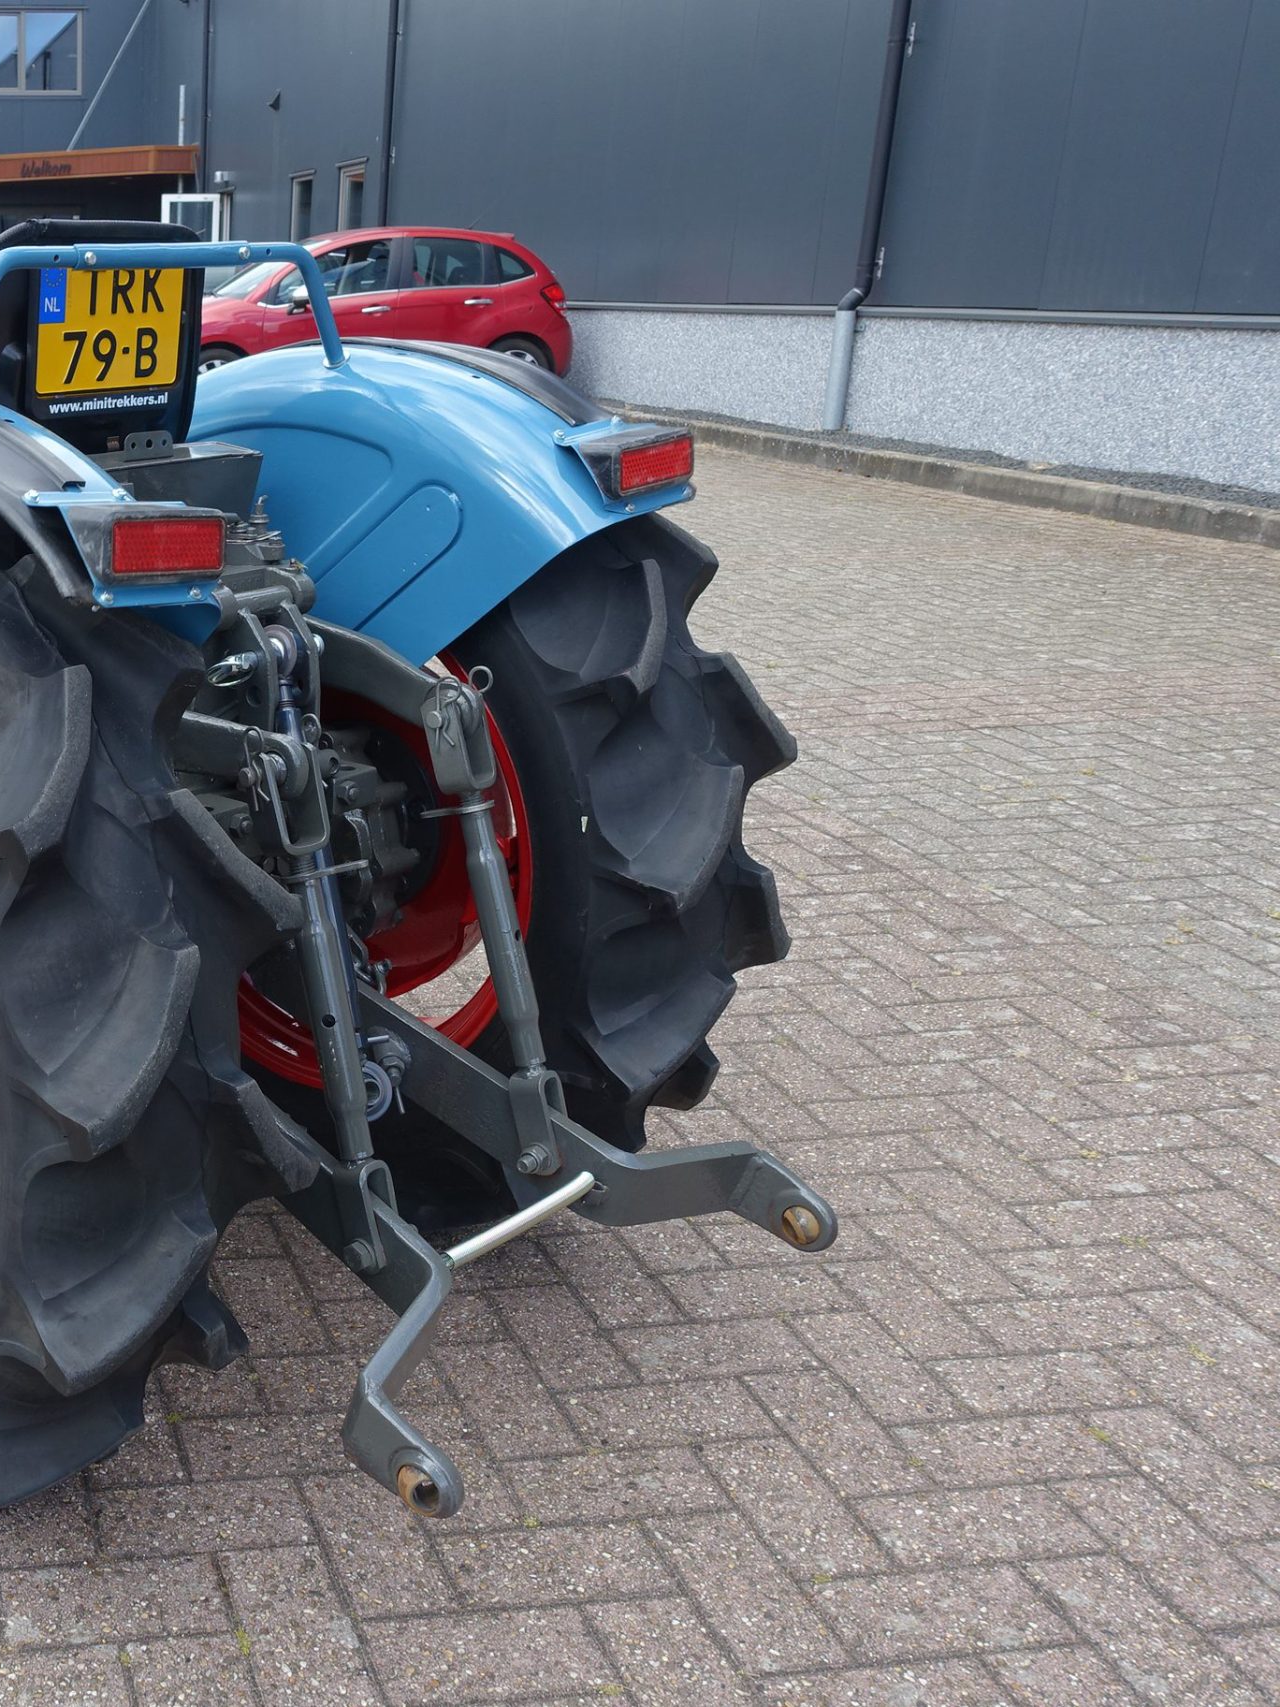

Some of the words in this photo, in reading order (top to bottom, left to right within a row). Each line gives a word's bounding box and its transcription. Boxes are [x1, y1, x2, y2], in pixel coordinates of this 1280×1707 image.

[20, 159, 72, 178] Welkom
[44, 297, 61, 313] NL
[49, 392, 169, 415] www.minitrekkers.nl
